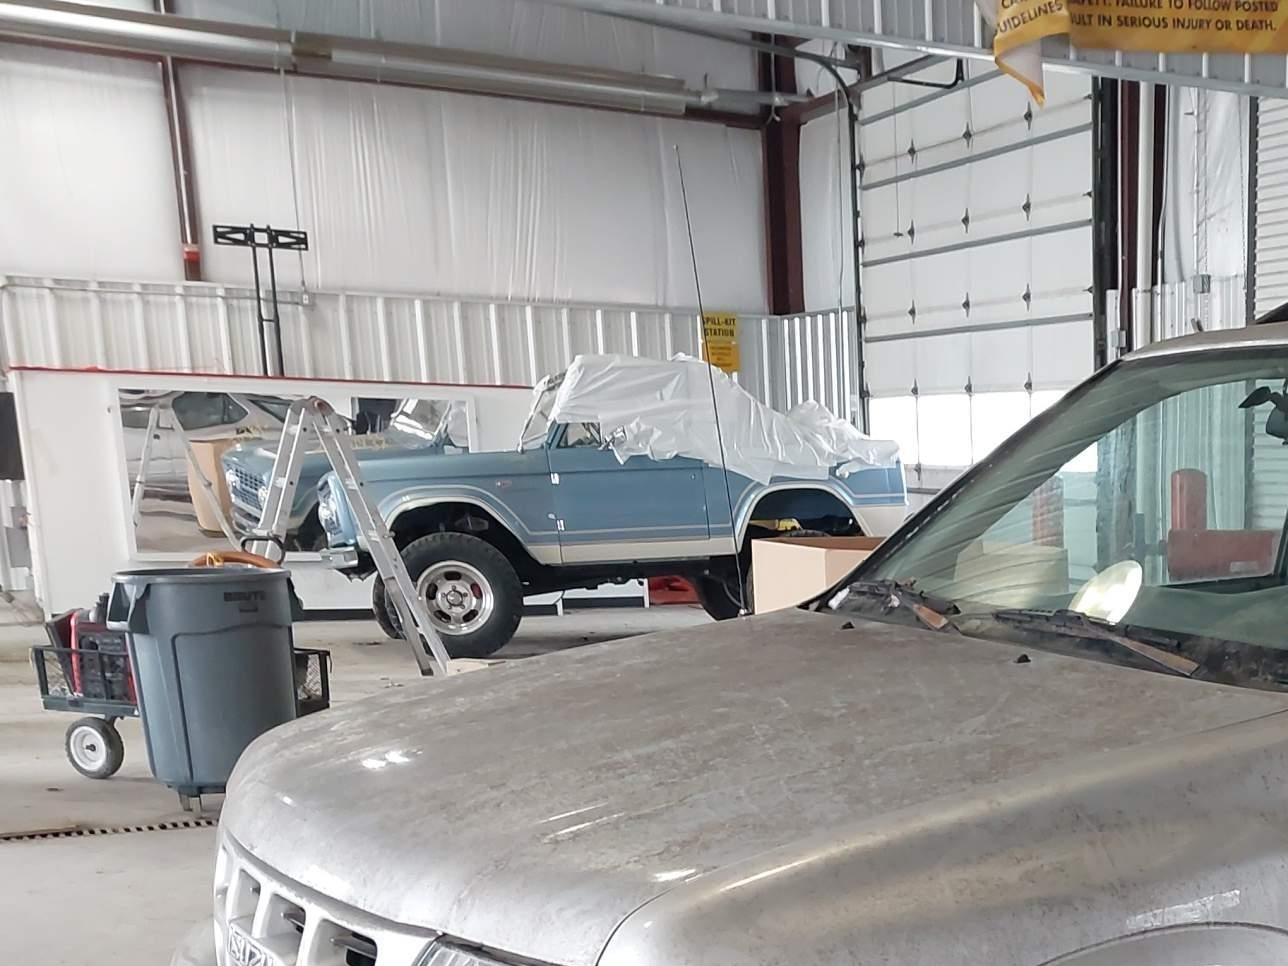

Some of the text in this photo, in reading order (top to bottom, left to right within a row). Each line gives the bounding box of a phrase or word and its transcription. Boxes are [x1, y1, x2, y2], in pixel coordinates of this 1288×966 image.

[1168, 0, 1184, 9] TO
[1188, 0, 1231, 11] FOLLOW
[1235, 1, 1278, 12] POSTED
[995, 1, 1064, 34] UIDELINES
[1072, 14, 1277, 31] ULT IN SERIOUS INJURY OR DEATH.
